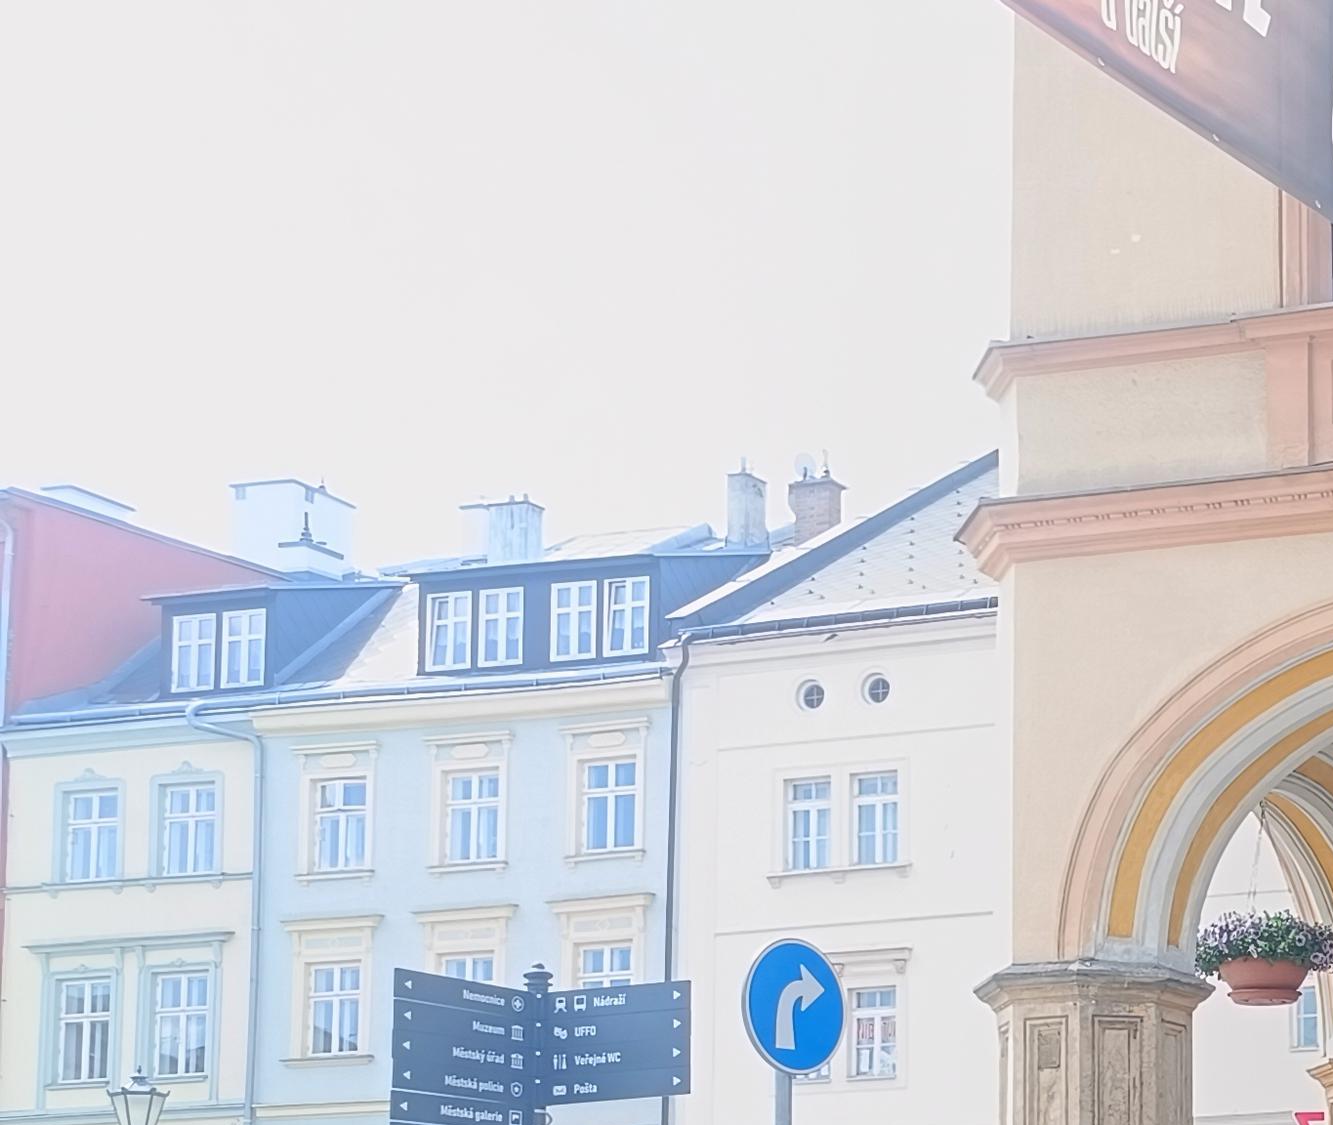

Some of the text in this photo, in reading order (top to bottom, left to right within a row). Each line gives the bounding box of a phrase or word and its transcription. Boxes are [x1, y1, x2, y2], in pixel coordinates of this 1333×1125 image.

[463, 989, 506, 1007] Nemocnice
[593, 993, 626, 1008] Nádraží
[472, 1020, 505, 1036] Muzeum
[574, 1026, 596, 1037] UFFO
[452, 1046, 505, 1065] Městský úřad
[574, 1052, 621, 1068] Veřejné WC
[445, 1075, 504, 1096] Městská policie
[573, 1084, 598, 1095] Pošta
[440, 1105, 503, 1124] Městská galerie
